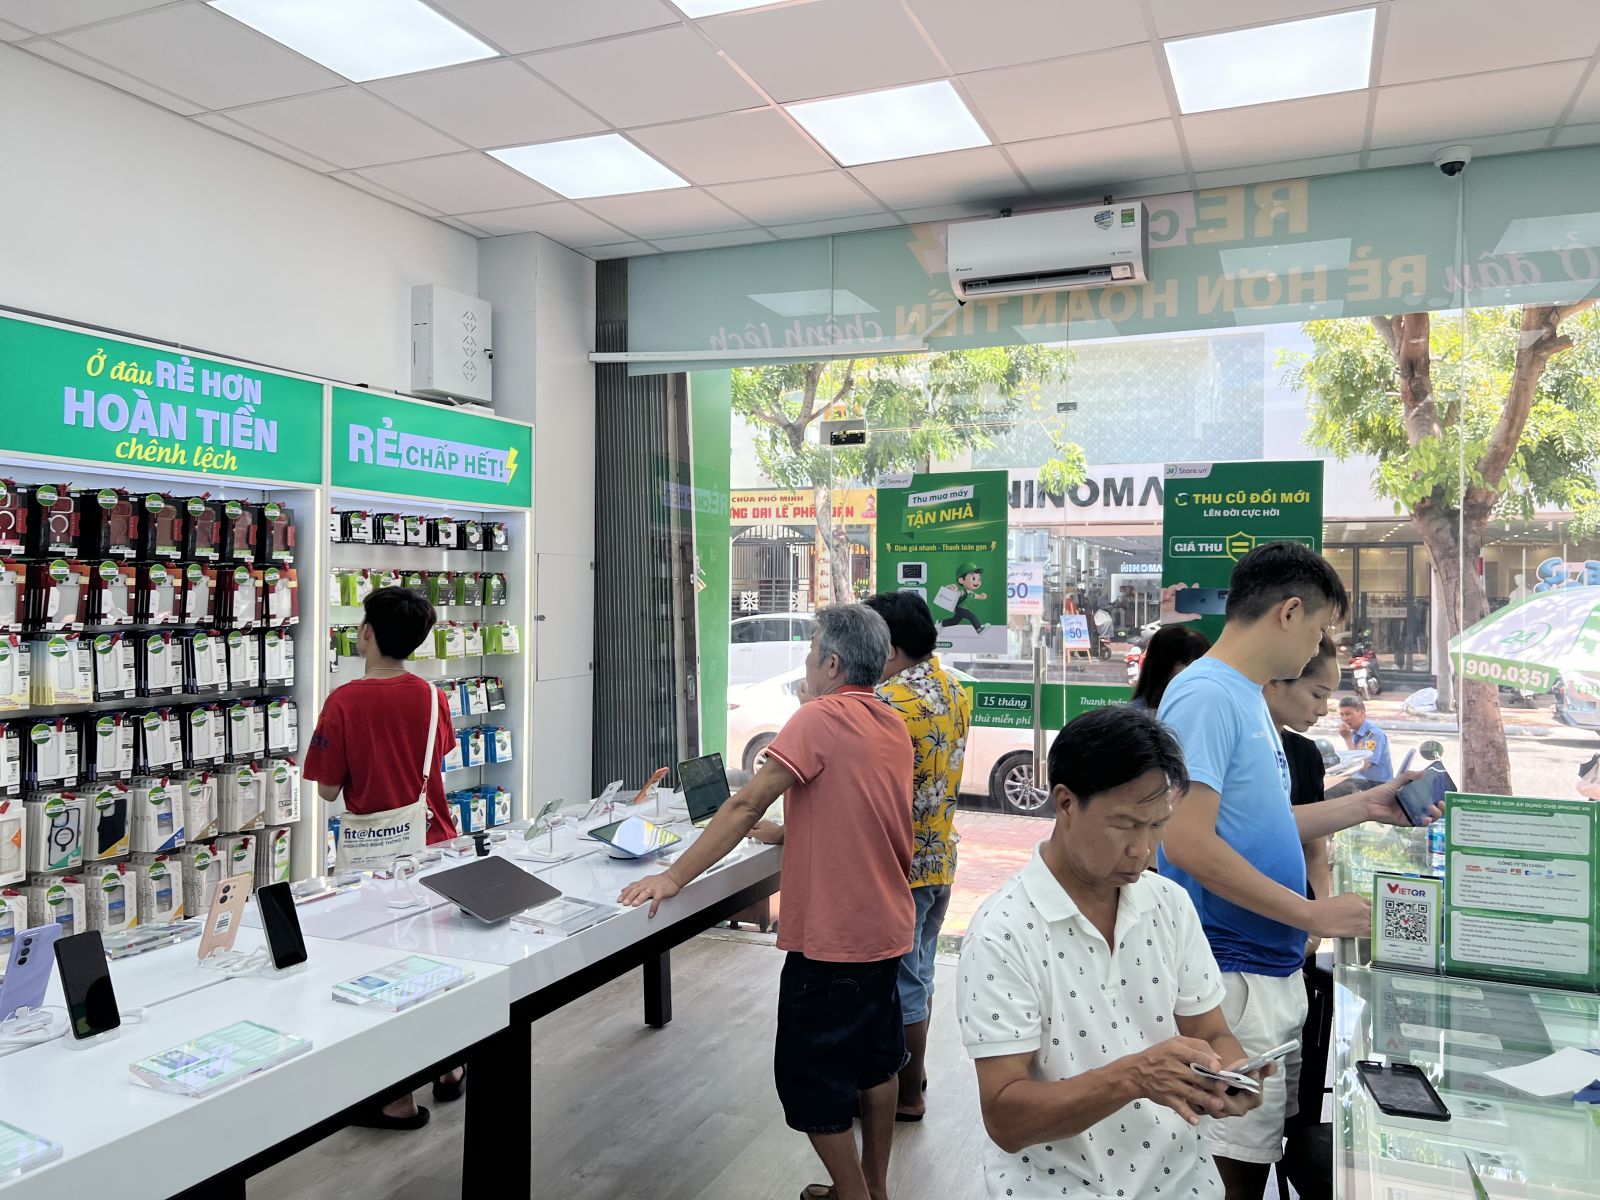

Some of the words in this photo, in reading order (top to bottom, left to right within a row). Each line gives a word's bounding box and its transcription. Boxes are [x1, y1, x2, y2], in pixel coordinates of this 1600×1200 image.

[86, 348, 106, 378] Ở
[109, 361, 153, 386] đâu
[156, 356, 194, 392] RẺ
[201, 370, 262, 405] HƠN
[63, 386, 187, 442] HOÀN
[196, 403, 278, 453] TIỀN
[348, 416, 402, 468] RẺ
[406, 443, 460, 472] CHẤP
[115, 436, 186, 466] chênh
[193, 444, 238, 472] lệch
[912, 495, 927, 504] Thu
[929, 492, 948, 501] mua
[950, 489, 969, 500] máy
[1193, 493, 1222, 504] THU
[1226, 490, 1246, 504] CŨ
[1249, 489, 1277, 504] ĐỔI
[1280, 490, 1310, 503] MỚI
[907, 511, 936, 528] TẬN
[939, 503, 974, 522] NHÀ
[1204, 509, 1221, 517] LÊN
[1174, 541, 1197, 552] GIÁ
[1198, 543, 1223, 552] THU
[1069, 627, 1082, 639] 50
[983, 695, 995, 706] 15
[997, 696, 1028, 710] tháng
[1080, 695, 1106, 706] Thanh
[992, 713, 1014, 725] miễn
[1015, 715, 1032, 727] phí
[344, 822, 410, 840] fit@hcmus
[1387, 883, 1426, 898] VIETQR
